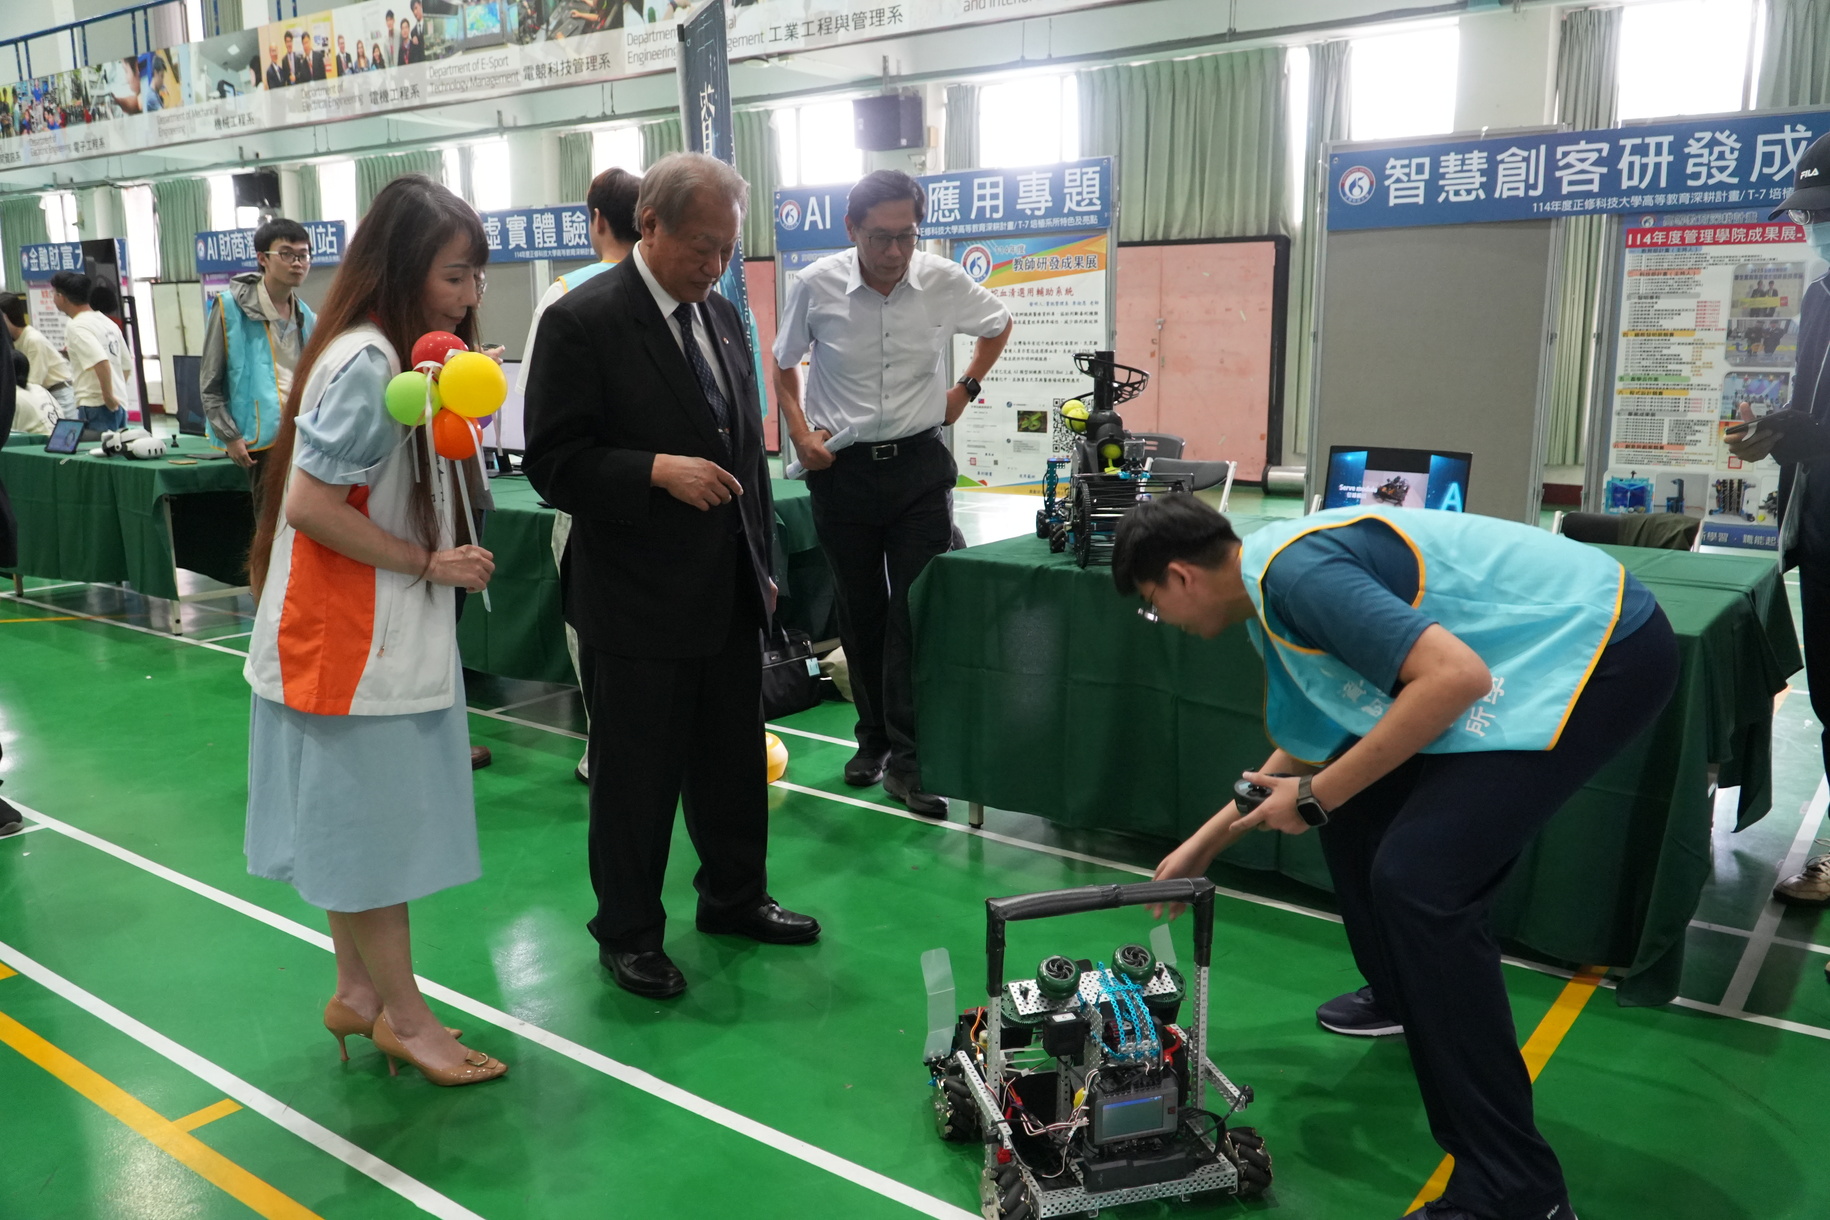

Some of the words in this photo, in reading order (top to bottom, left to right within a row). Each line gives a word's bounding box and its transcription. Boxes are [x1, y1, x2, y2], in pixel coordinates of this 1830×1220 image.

[768, 5, 904, 43] 工業工程與管理系
[626, 28, 678, 46] Departmen
[429, 61, 471, 79] Department
[471, 58, 480, 72] of
[480, 55, 509, 71] E-Sport
[522, 52, 611, 81] 電競科技管理系
[429, 76, 469, 94] Technology
[469, 71, 519, 89] Management
[369, 83, 420, 105] 電機工程系
[214, 112, 255, 131] 機械工程系
[1383, 124, 1812, 206] 智慧創客研發成
[1799, 167, 1820, 180] FILA
[927, 166, 1103, 223] 應用專題
[1747, 188, 1766, 200] T-7
[803, 195, 831, 231] AI
[1628, 226, 1807, 246] 114年度管理學院成果展-
[1013, 255, 1098, 272] 教師研發成果展
